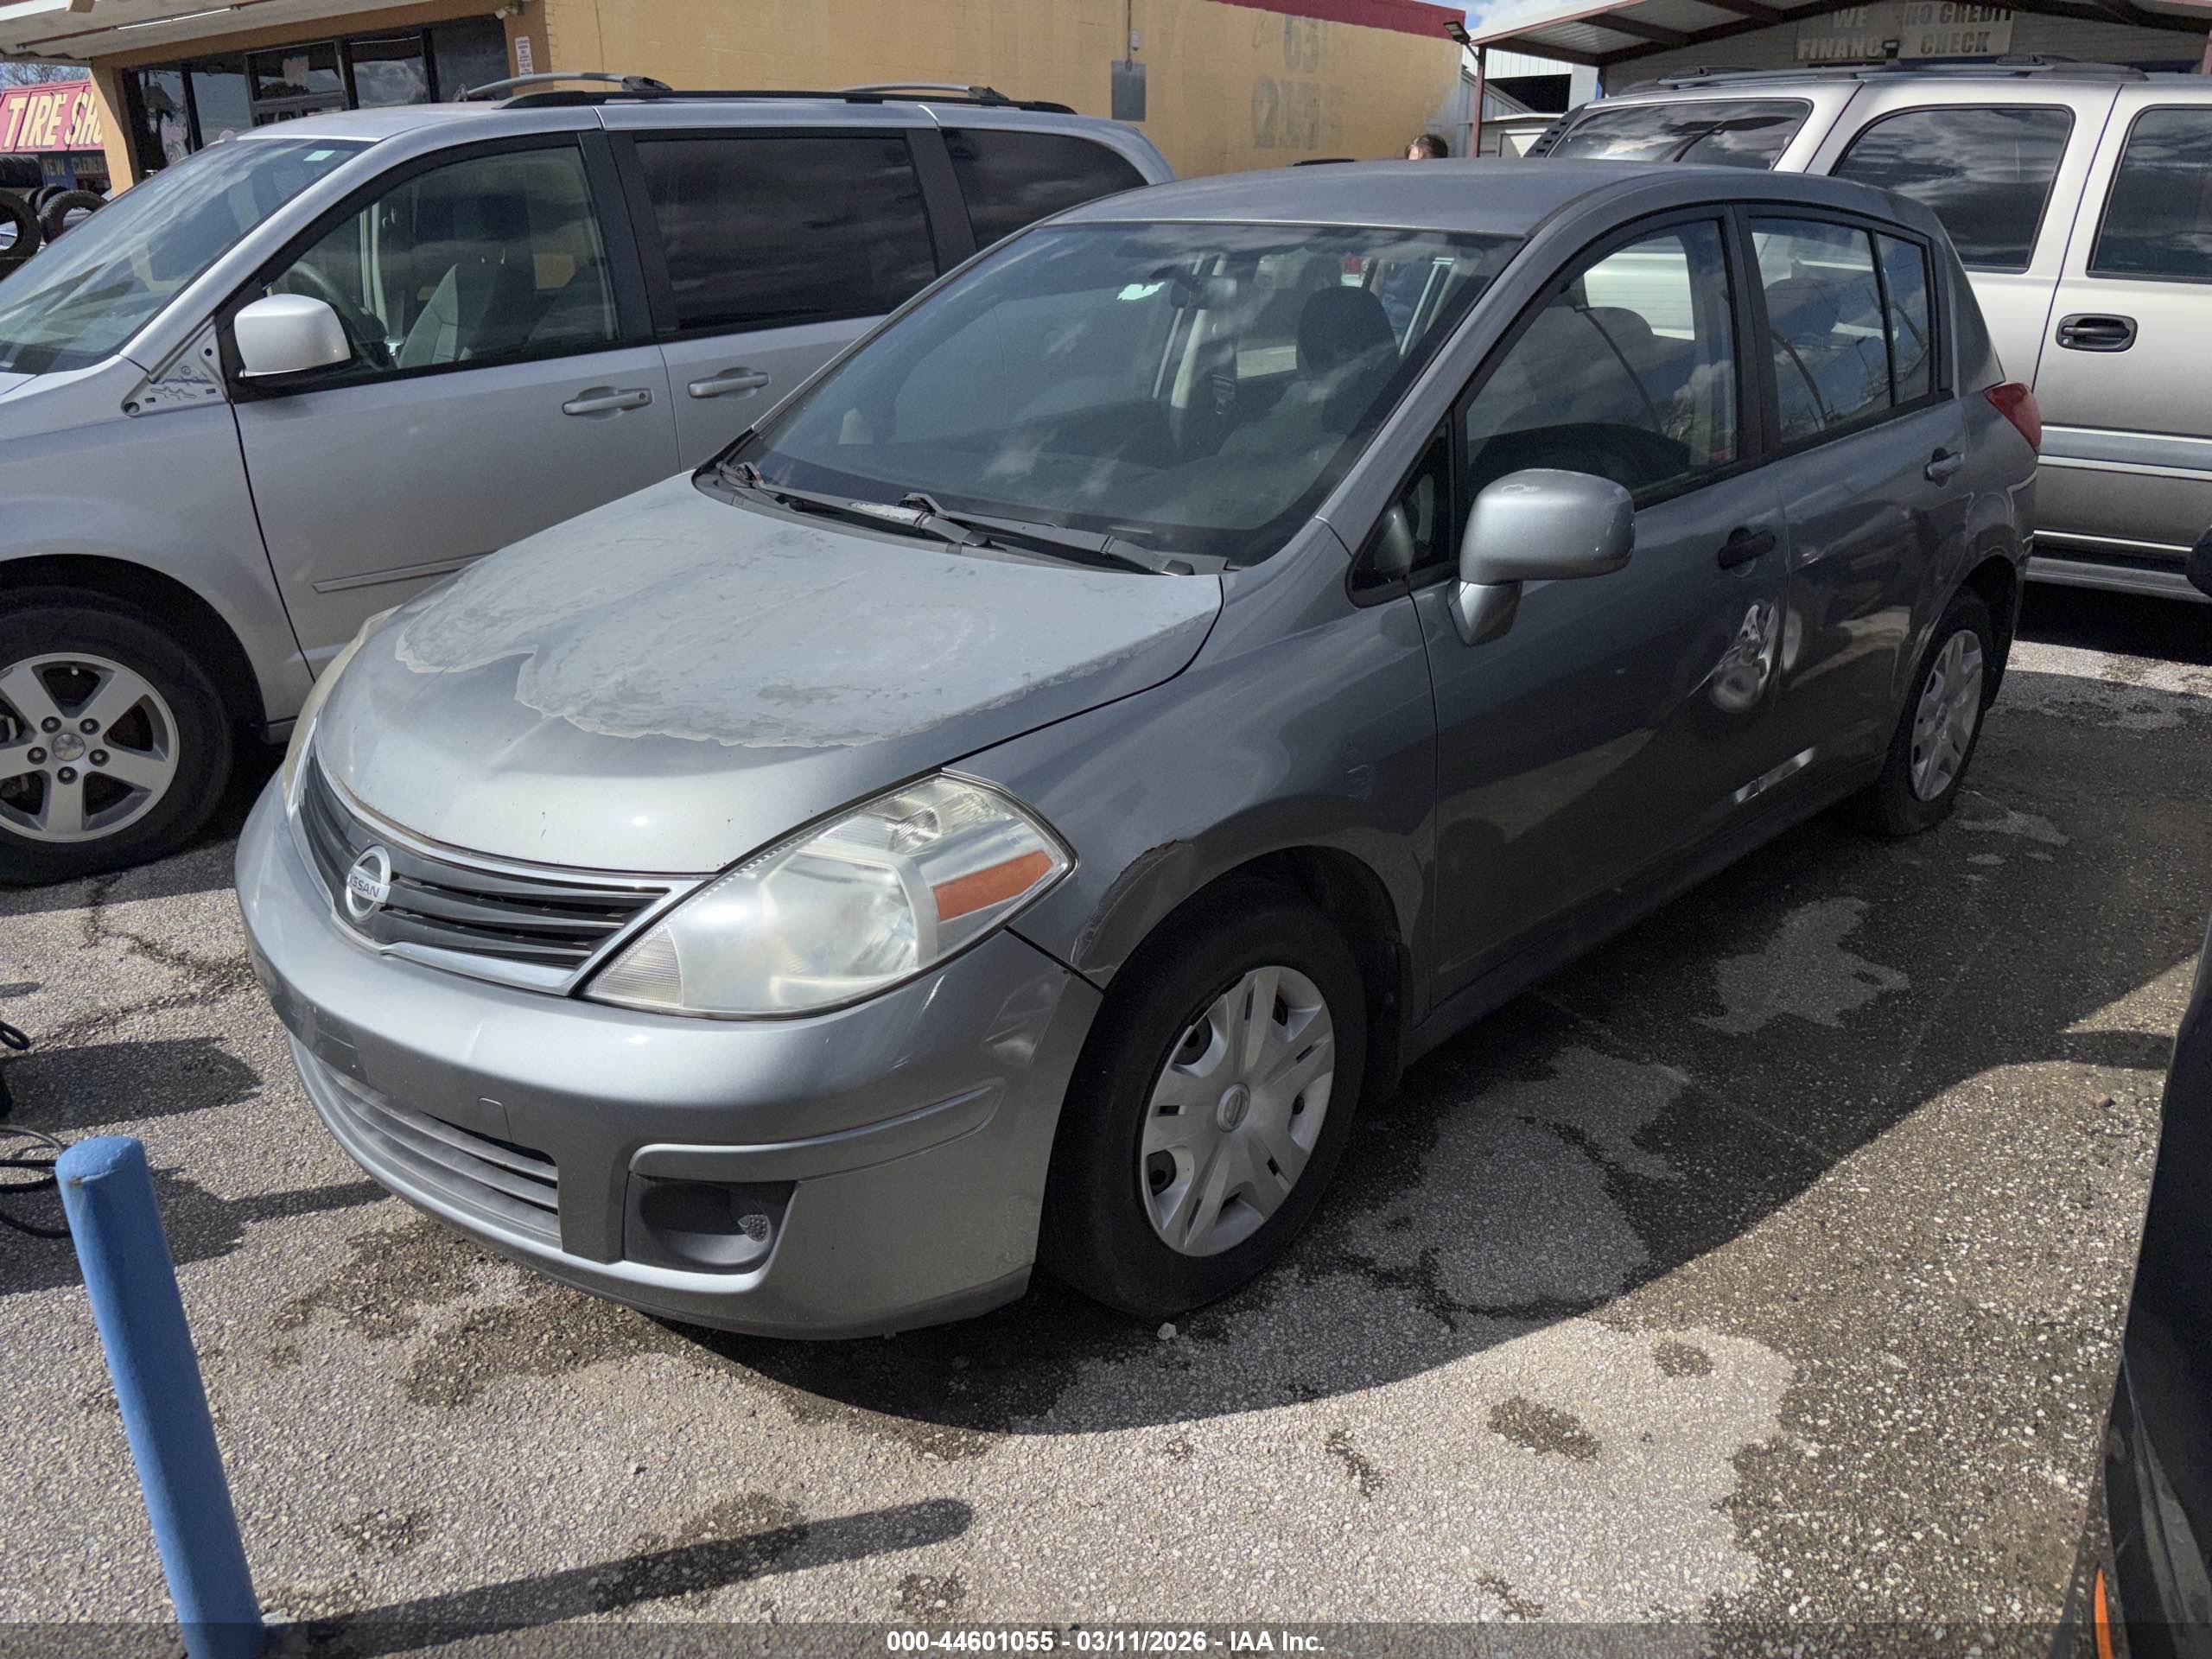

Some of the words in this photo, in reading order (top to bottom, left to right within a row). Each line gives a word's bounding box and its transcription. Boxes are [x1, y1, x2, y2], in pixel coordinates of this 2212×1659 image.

[1831, 8, 1866, 29] WE
[1905, 3, 1934, 25] NO
[1939, 3, 2012, 24] CREDIT
[1797, 35, 1884, 60] FINANC
[1920, 30, 1991, 54] CHECK
[3, 93, 68, 147] TIRE
